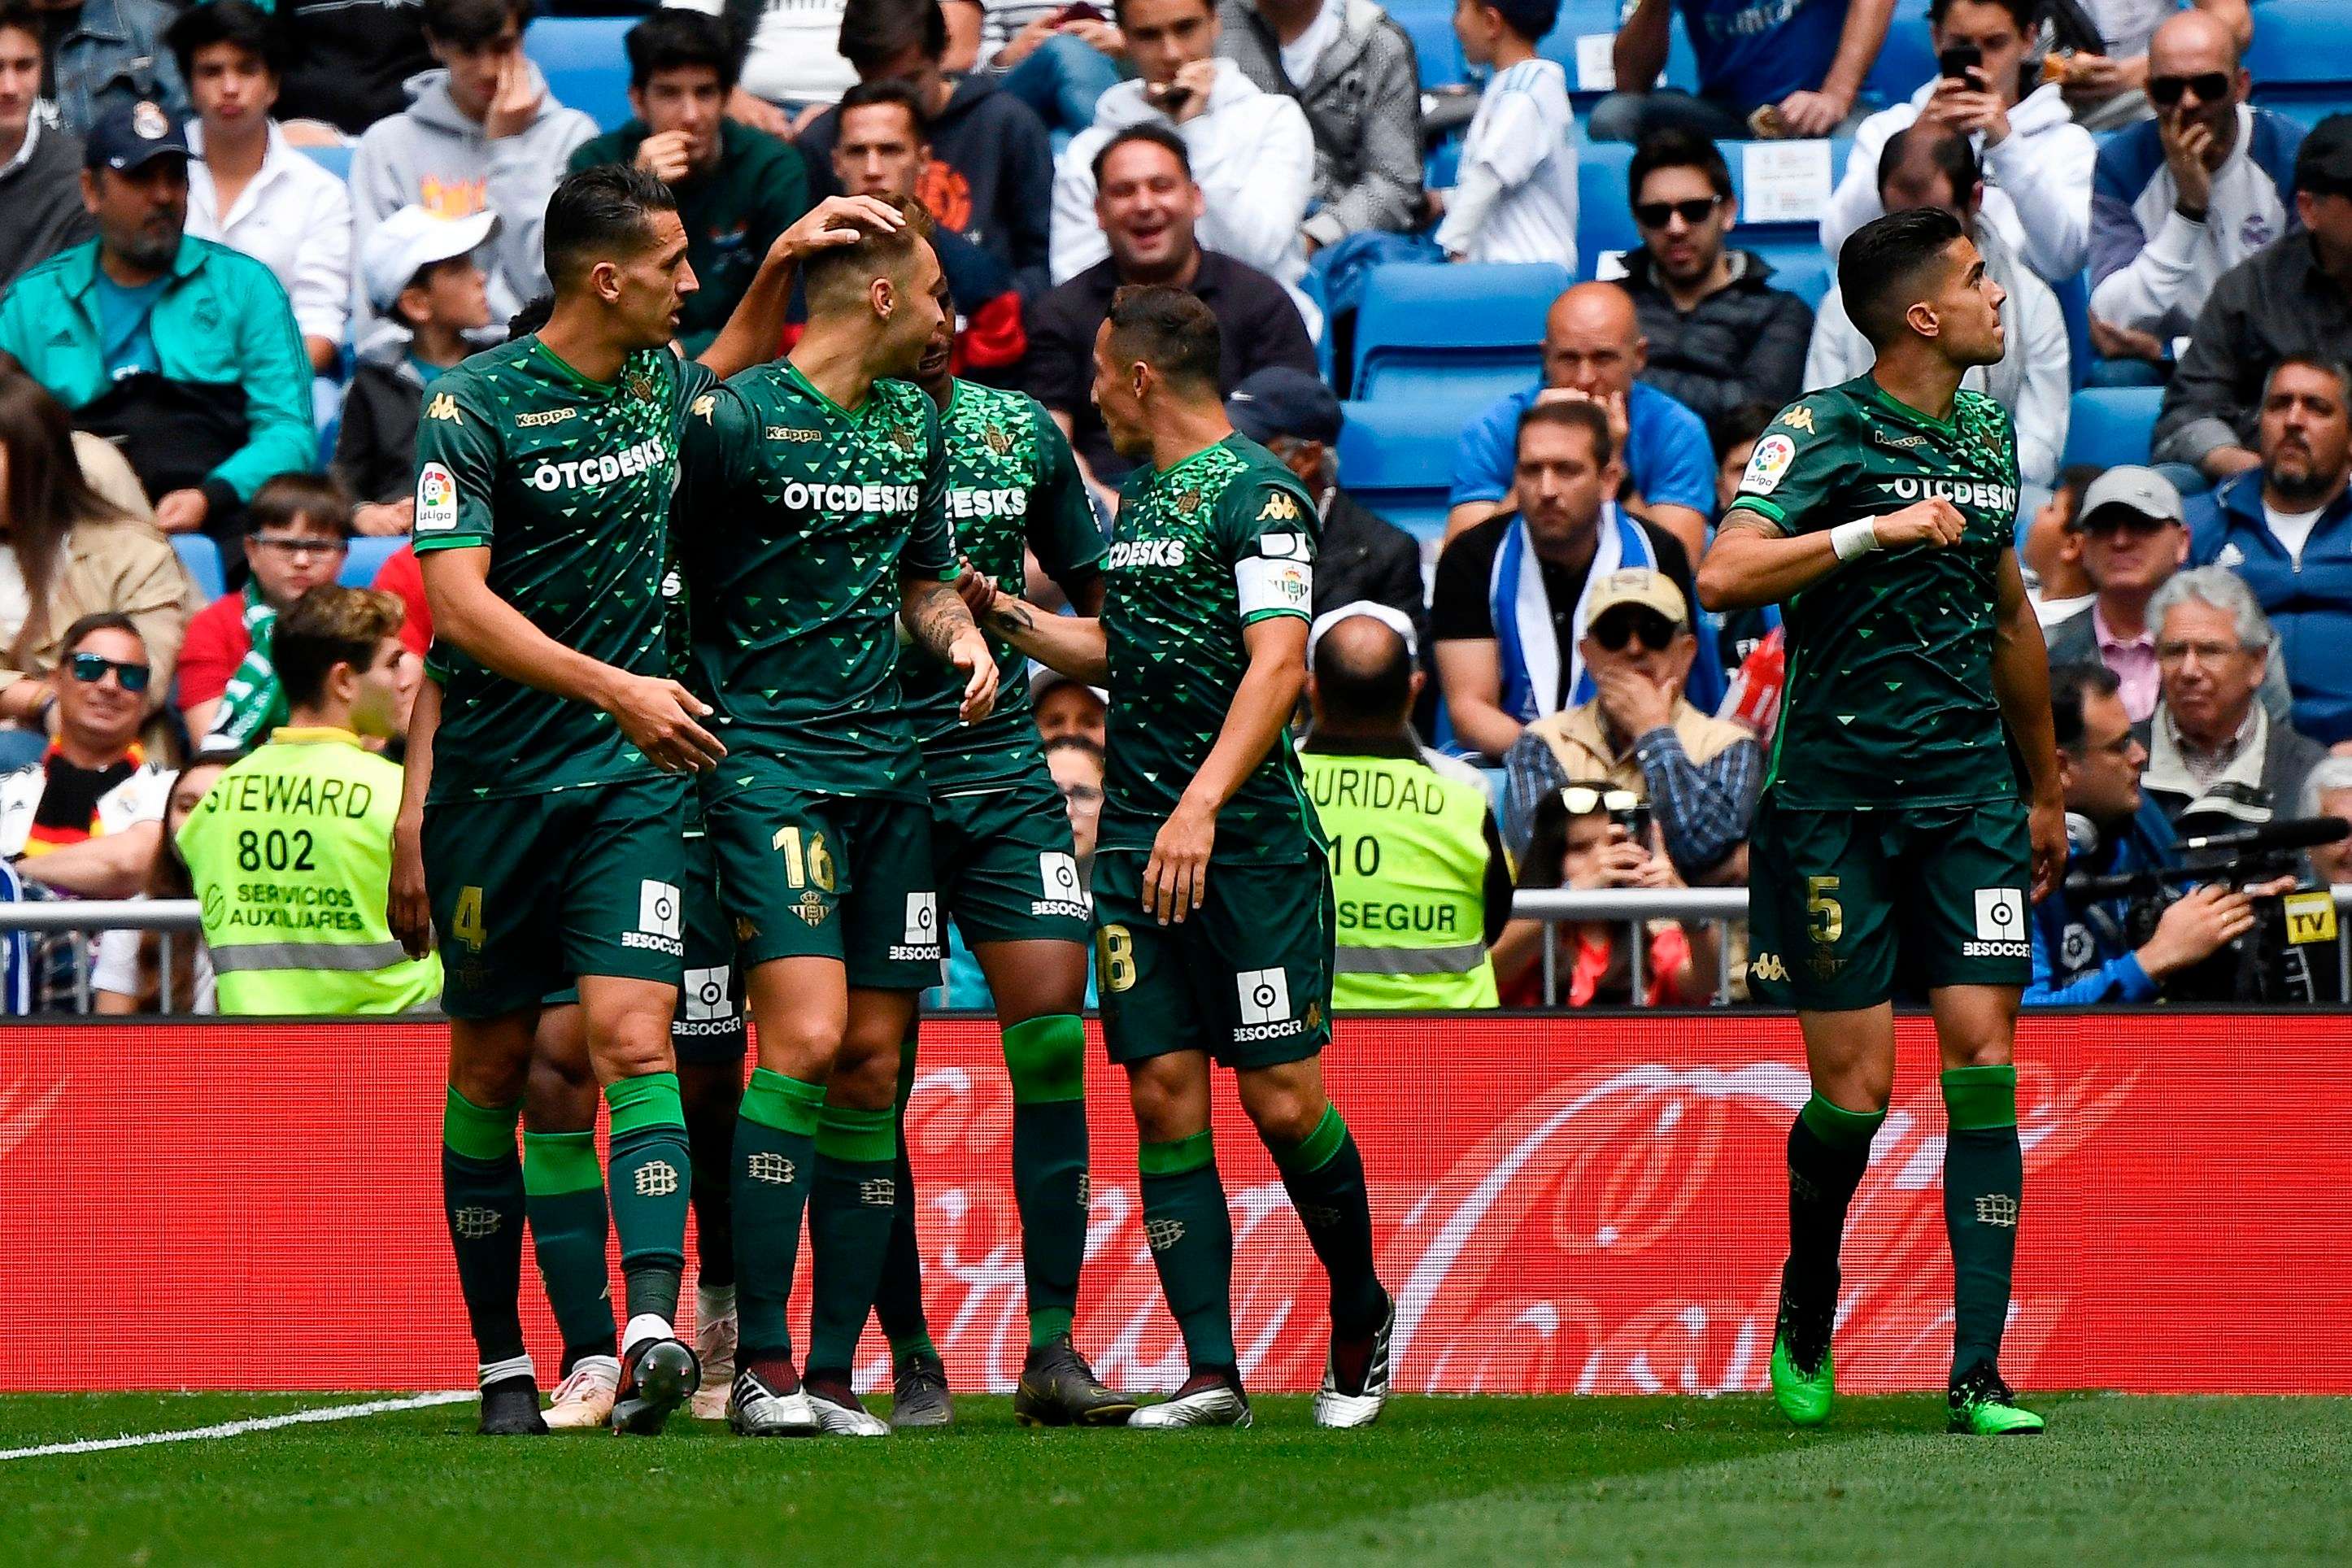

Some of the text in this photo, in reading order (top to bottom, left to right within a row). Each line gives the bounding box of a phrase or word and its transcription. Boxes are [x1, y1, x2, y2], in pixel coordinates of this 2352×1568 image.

[516, 407, 577, 428] Kappa
[766, 427, 822, 442] Kappa
[534, 435, 666, 491] OTCDESKS
[783, 483, 920, 513] OTCDESKS
[945, 488, 1026, 518] ESKS
[205, 775, 372, 819] STEWARD
[238, 829, 316, 872] 802
[773, 826, 836, 893] 16
[237, 883, 353, 908] SERVICIOS
[1808, 876, 1842, 943] 5
[229, 908, 364, 930] AUXILIARES
[452, 885, 486, 953] 4
[2293, 913, 2324, 934] TV
[1234, 1019, 1303, 1043] BESOCCER
